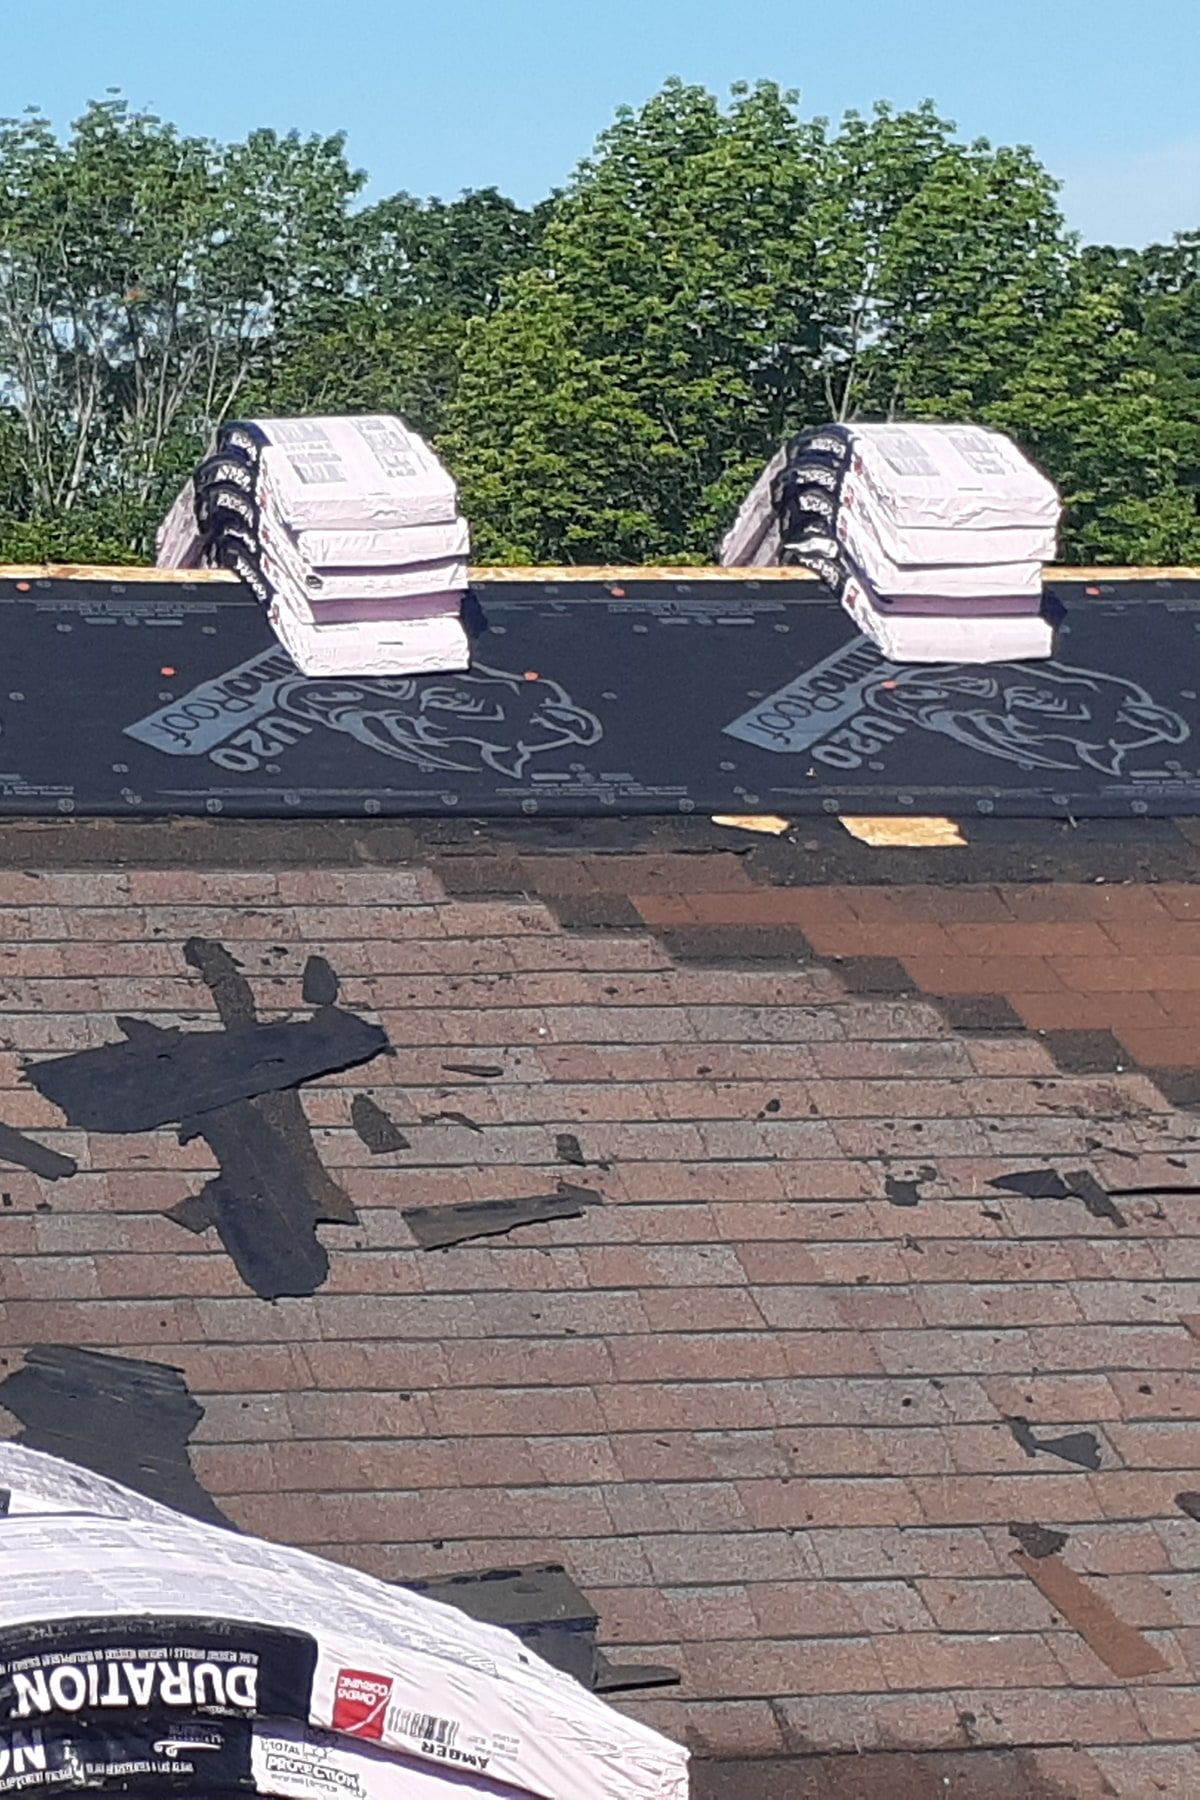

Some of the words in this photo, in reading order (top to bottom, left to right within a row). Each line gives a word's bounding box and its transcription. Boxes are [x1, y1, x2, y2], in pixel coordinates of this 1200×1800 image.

[150, 650, 300, 748] inoRoof
[747, 641, 885, 745] hinoRoof
[209, 716, 312, 772] U20
[811, 714, 907, 770] U20
[12, 1661, 258, 1714] DURATION
[267, 1755, 360, 1787] PROTECTION
[421, 1741, 489, 1770] AMBER
